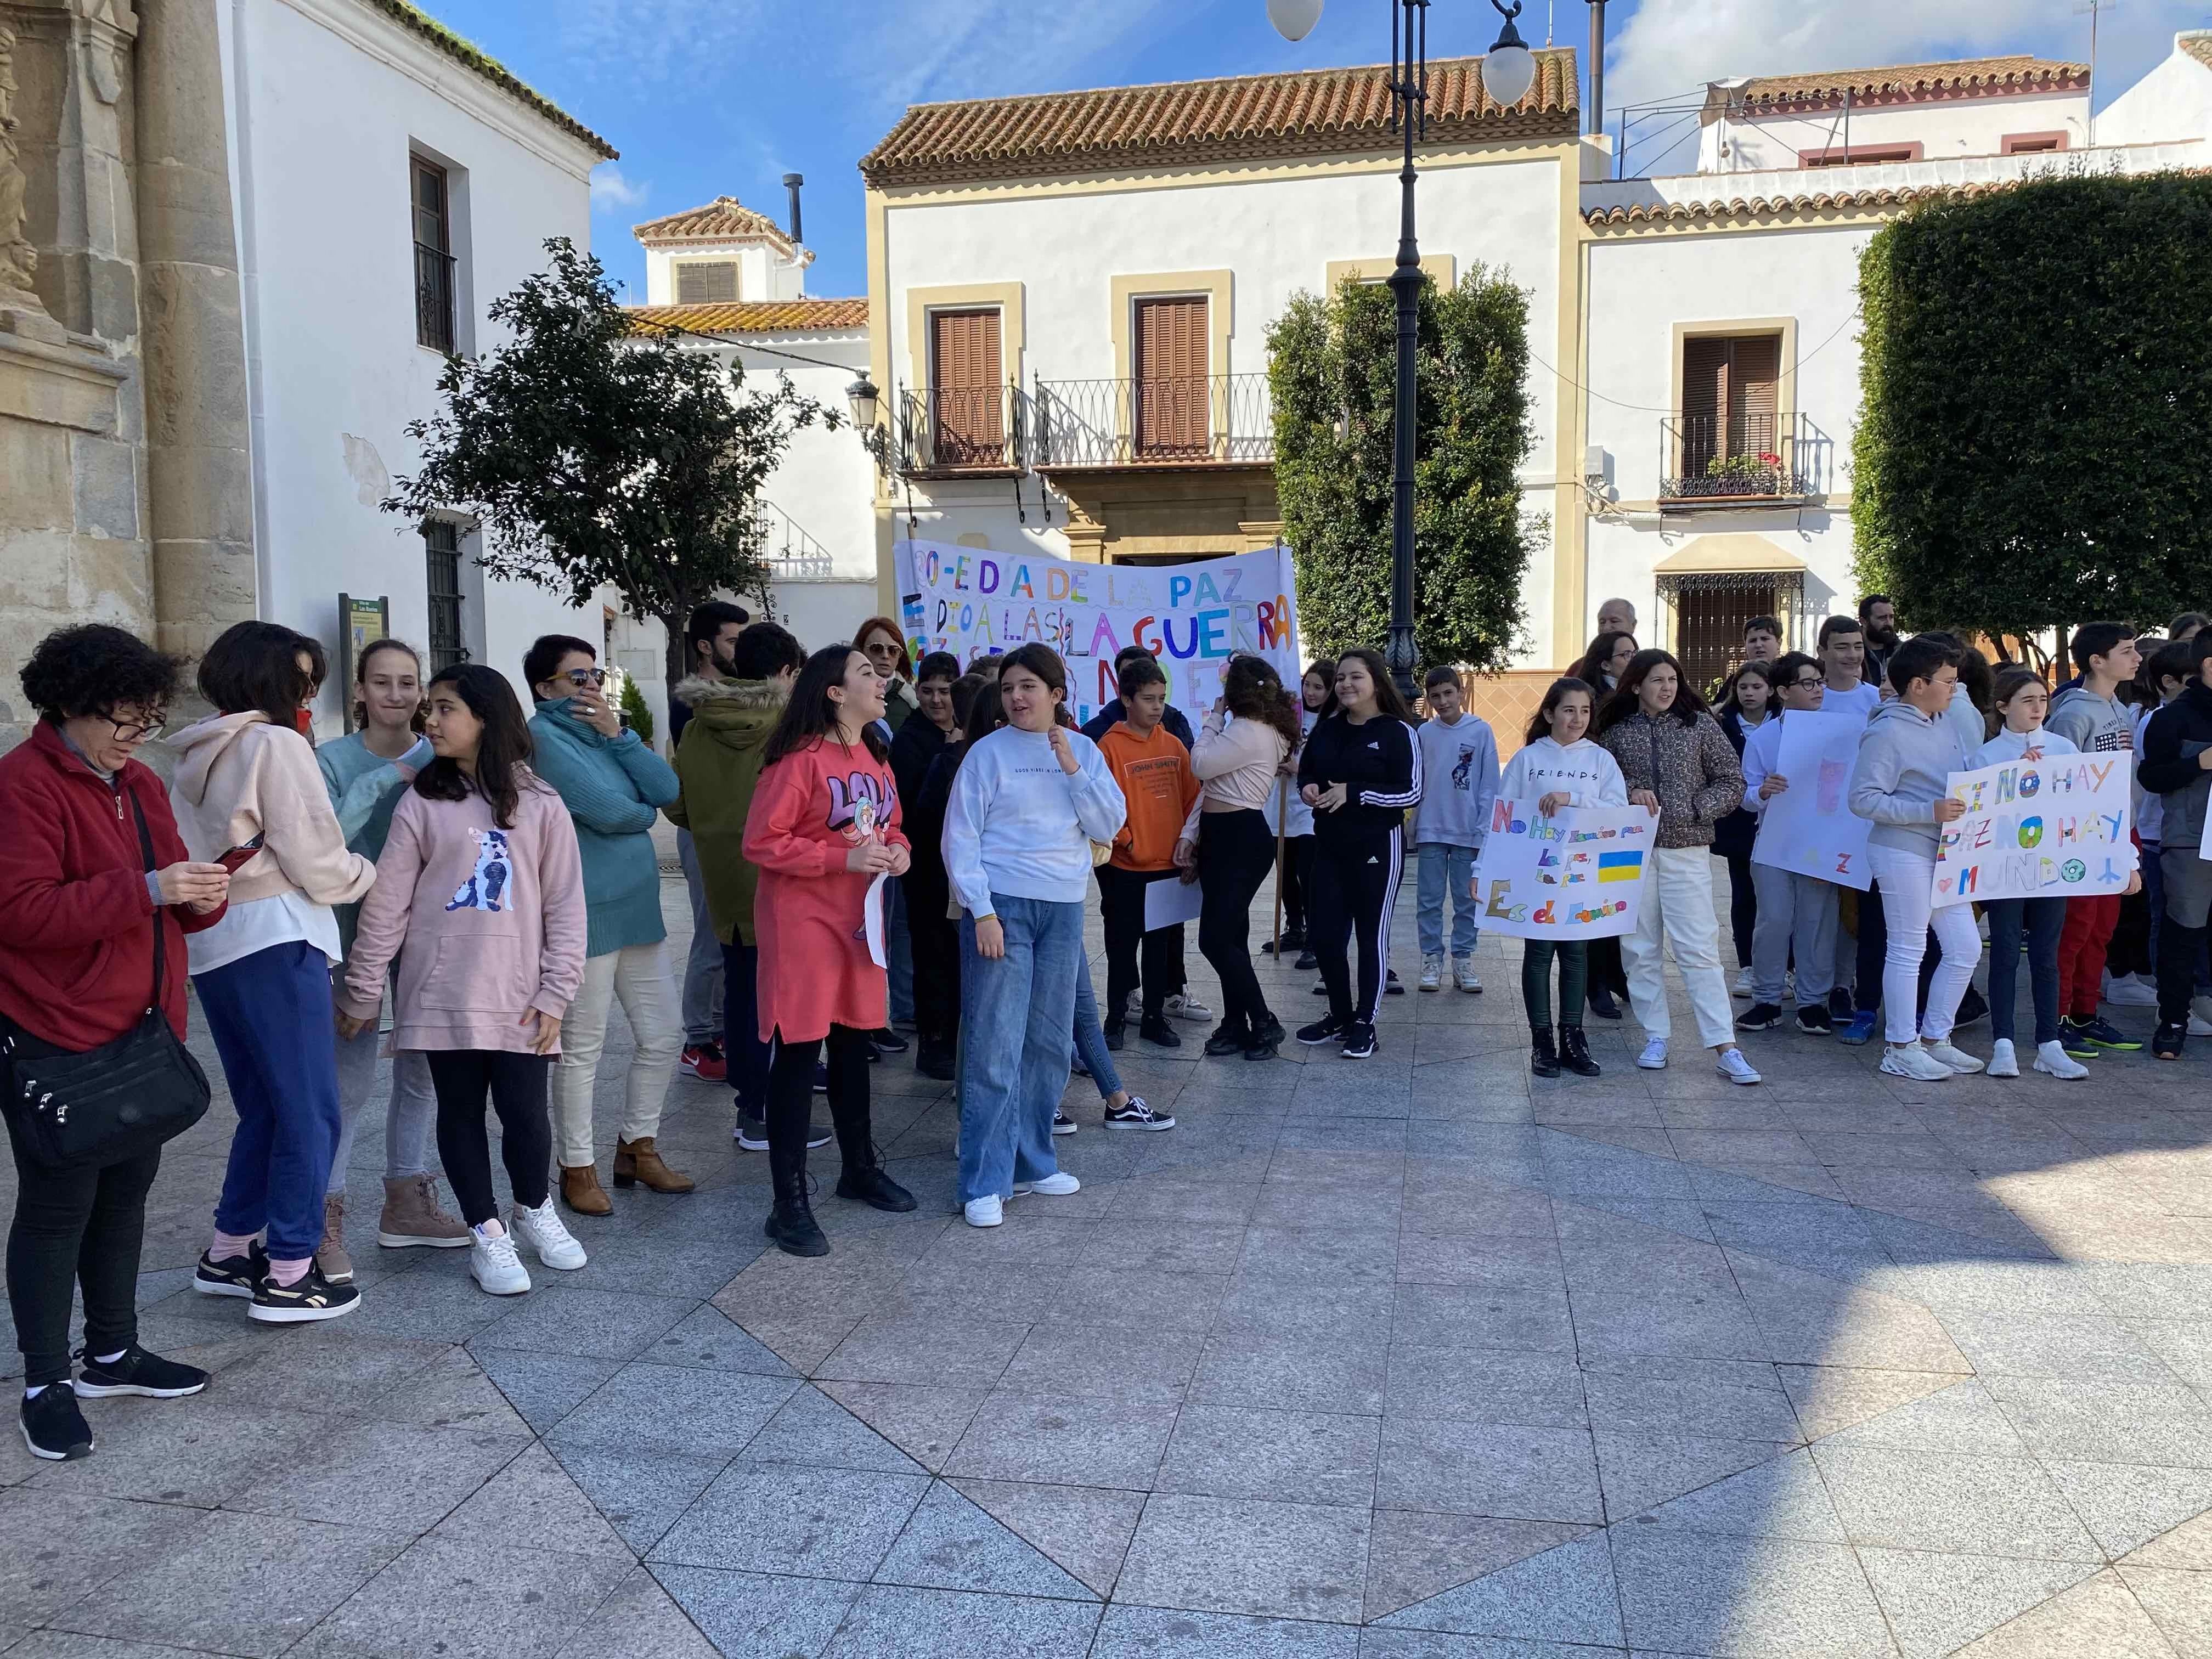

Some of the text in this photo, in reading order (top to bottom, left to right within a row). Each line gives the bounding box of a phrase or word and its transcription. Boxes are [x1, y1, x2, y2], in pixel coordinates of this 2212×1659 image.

[1047, 567, 1089, 603] DE
[1107, 575, 1153, 607] LA
[1170, 568, 1243, 607] PAZ
[1065, 594, 1294, 659] LA GUERRA
[1528, 769, 1598, 781] FRIENDS
[1995, 768, 2041, 805] NO
[2052, 759, 2115, 794] HAY
[825, 771, 896, 832] LOLA
[1492, 799, 1527, 834] No
[1528, 815, 1566, 843] Hay
[1538, 848, 1560, 867] La
[1937, 809, 2124, 862] PAZ NO HAY
[1957, 853, 2086, 896] MUNDO
[1485, 879, 1528, 923] Es
